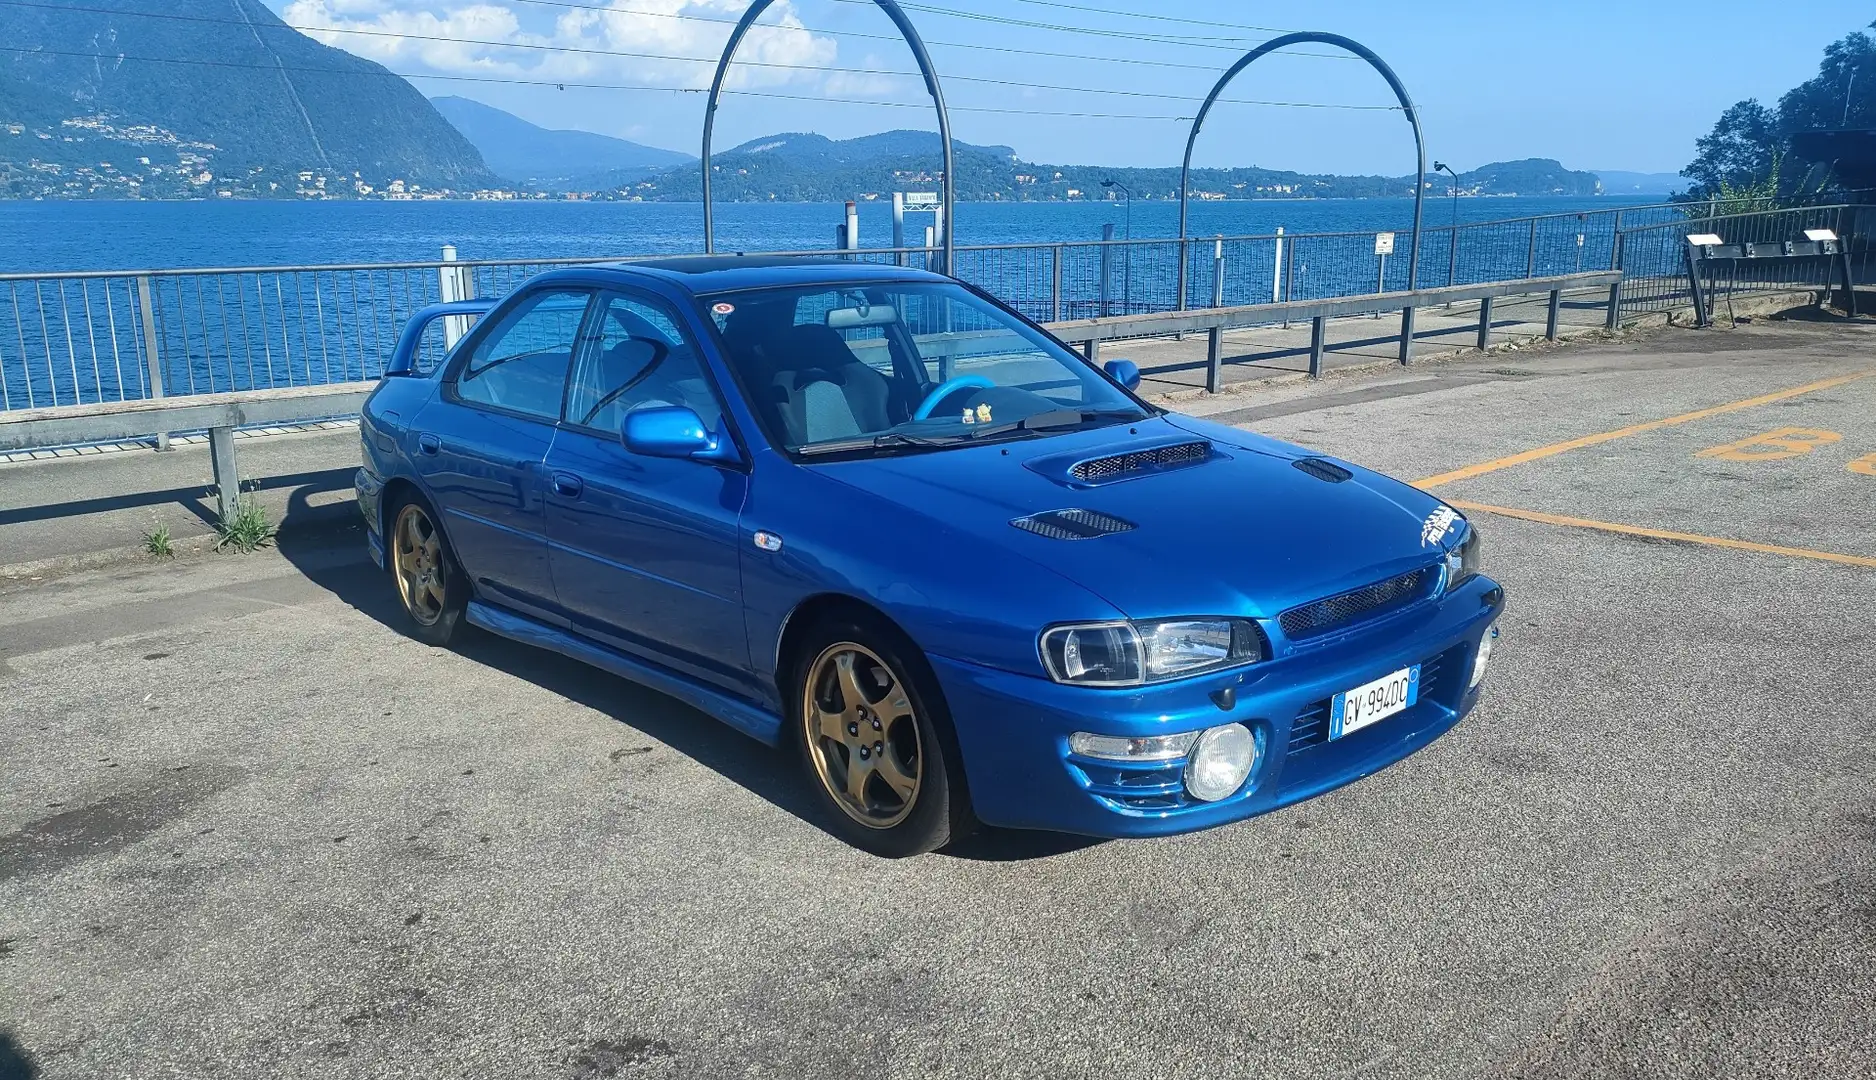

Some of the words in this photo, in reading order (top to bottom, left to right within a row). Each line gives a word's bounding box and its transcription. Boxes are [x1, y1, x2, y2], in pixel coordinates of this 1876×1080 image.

[1344, 695, 1362, 725] GV
[1368, 677, 1408, 716] 994DC
[1335, 717, 1340, 734] I
